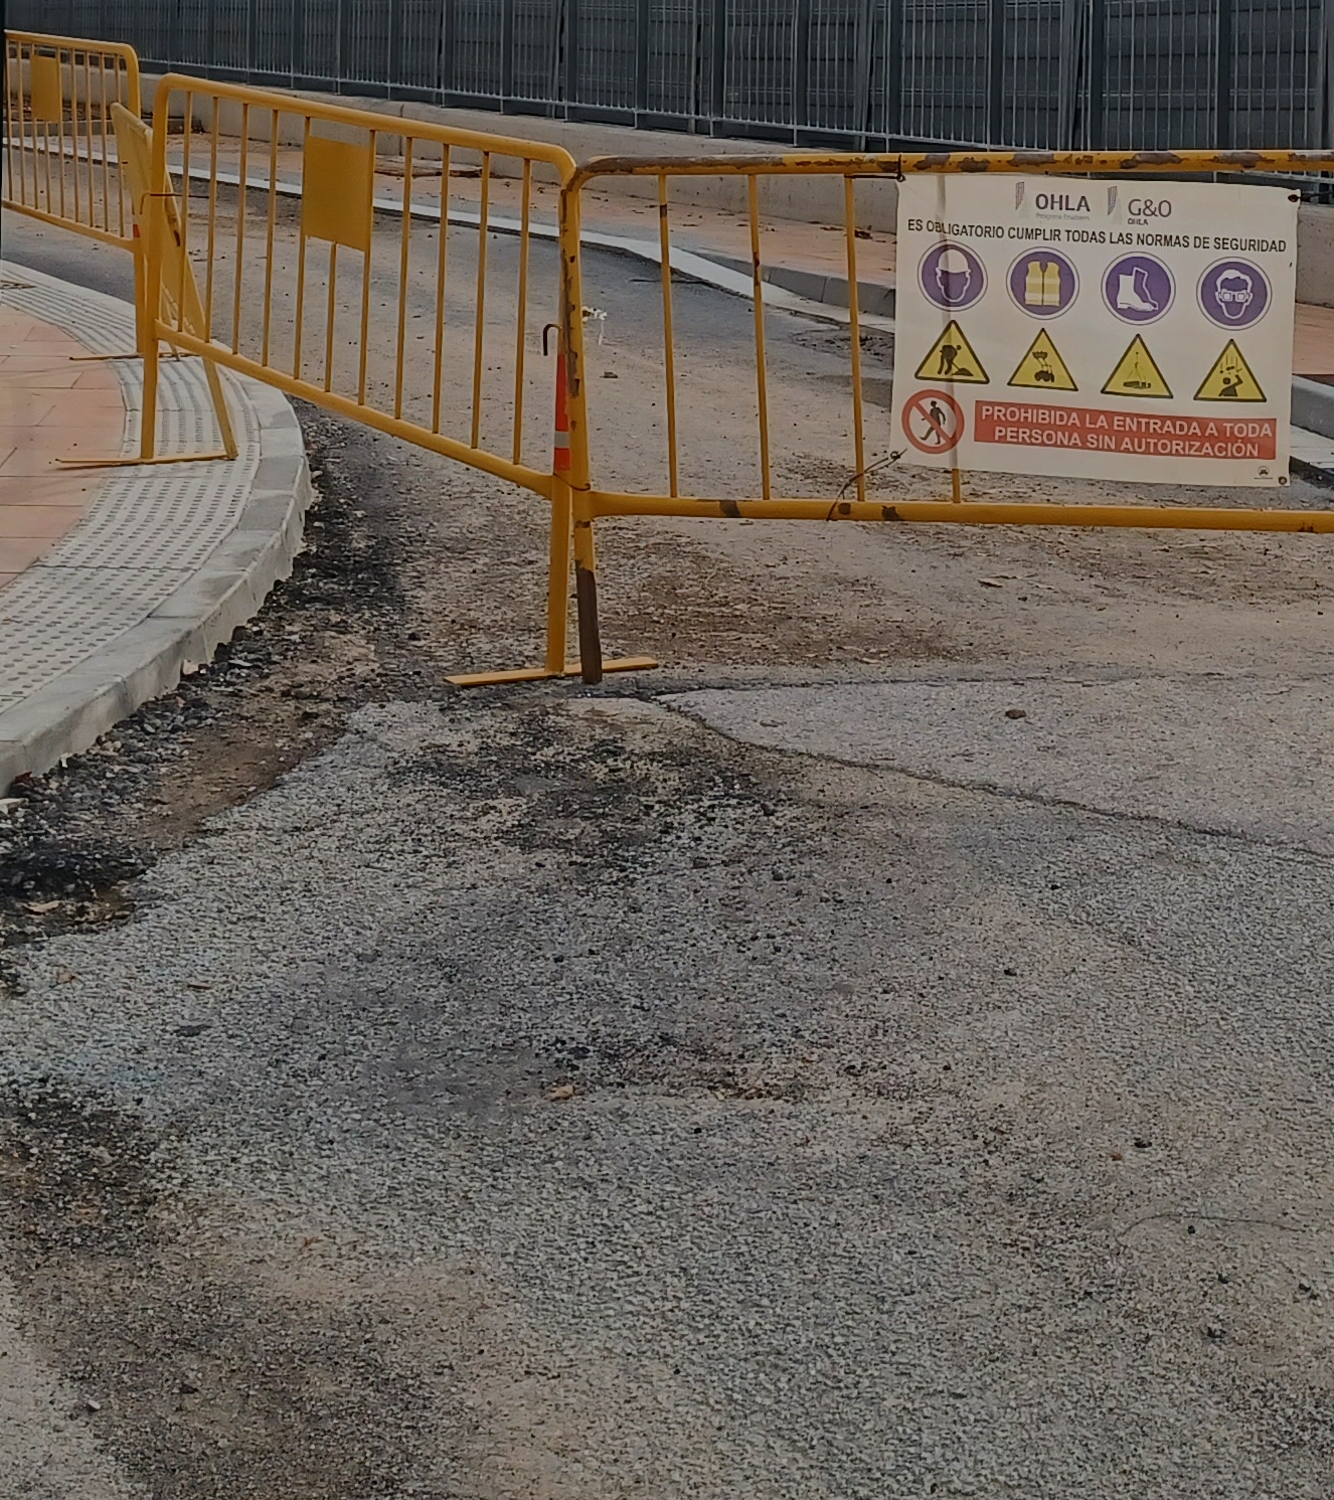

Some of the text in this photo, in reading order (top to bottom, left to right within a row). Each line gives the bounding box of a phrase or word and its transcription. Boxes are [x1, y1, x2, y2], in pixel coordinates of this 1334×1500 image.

[1035, 193, 1172, 218] OHLA G&O
[907, 218, 1287, 253] ES OBLIGATORIO CUMPLIR TODAS LAS NORMAS DE SEGURIDAD
[981, 405, 1273, 438] PROHIBIDA LA ENTRADA A TODA
[994, 426, 1259, 457] PERSONA SIN AUTORIZACIÓN
